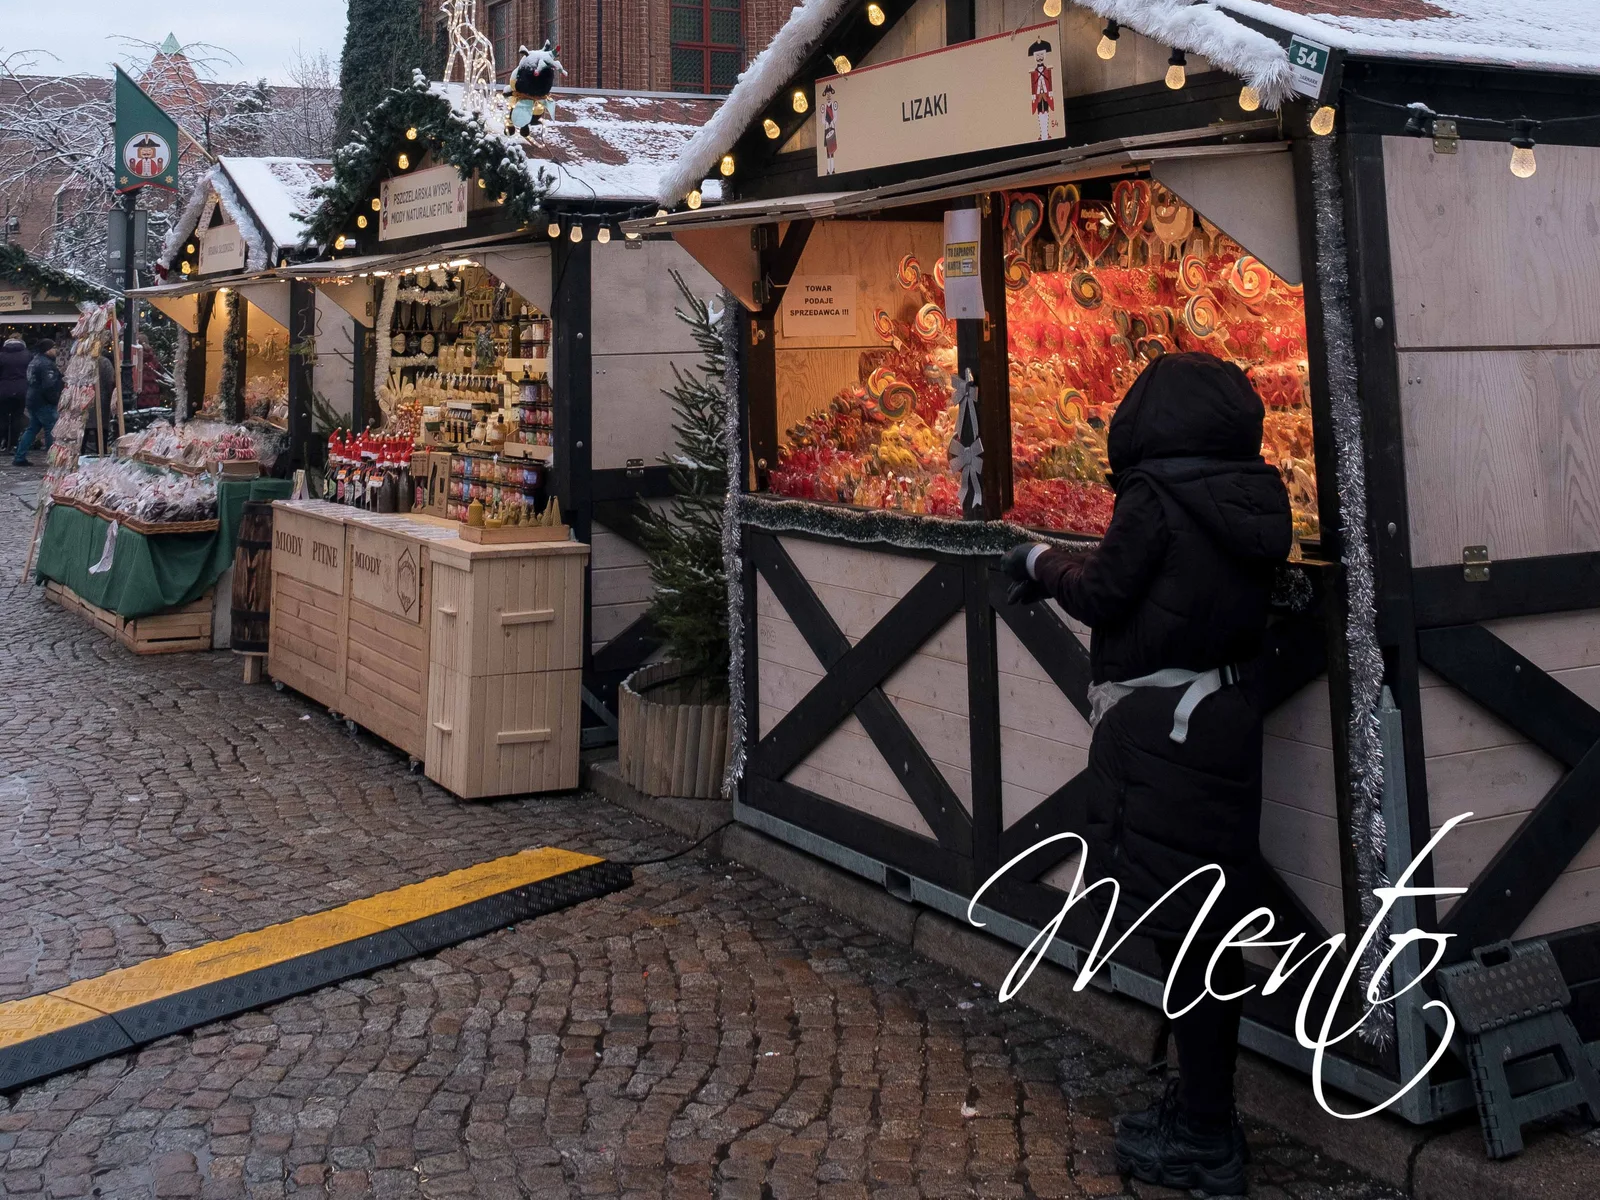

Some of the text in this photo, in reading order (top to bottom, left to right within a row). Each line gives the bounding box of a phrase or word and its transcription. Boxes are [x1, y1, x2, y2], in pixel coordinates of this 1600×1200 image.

[1297, 47, 1317, 69] 54
[902, 93, 948, 122] LIZAKI
[393, 182, 452, 205] PSZCZELARSKA WYSPA
[391, 201, 453, 224] MIODY NATURALNE PITNE
[275, 530, 338, 568] MIODY PITNE
[355, 551, 382, 575] MIODY
